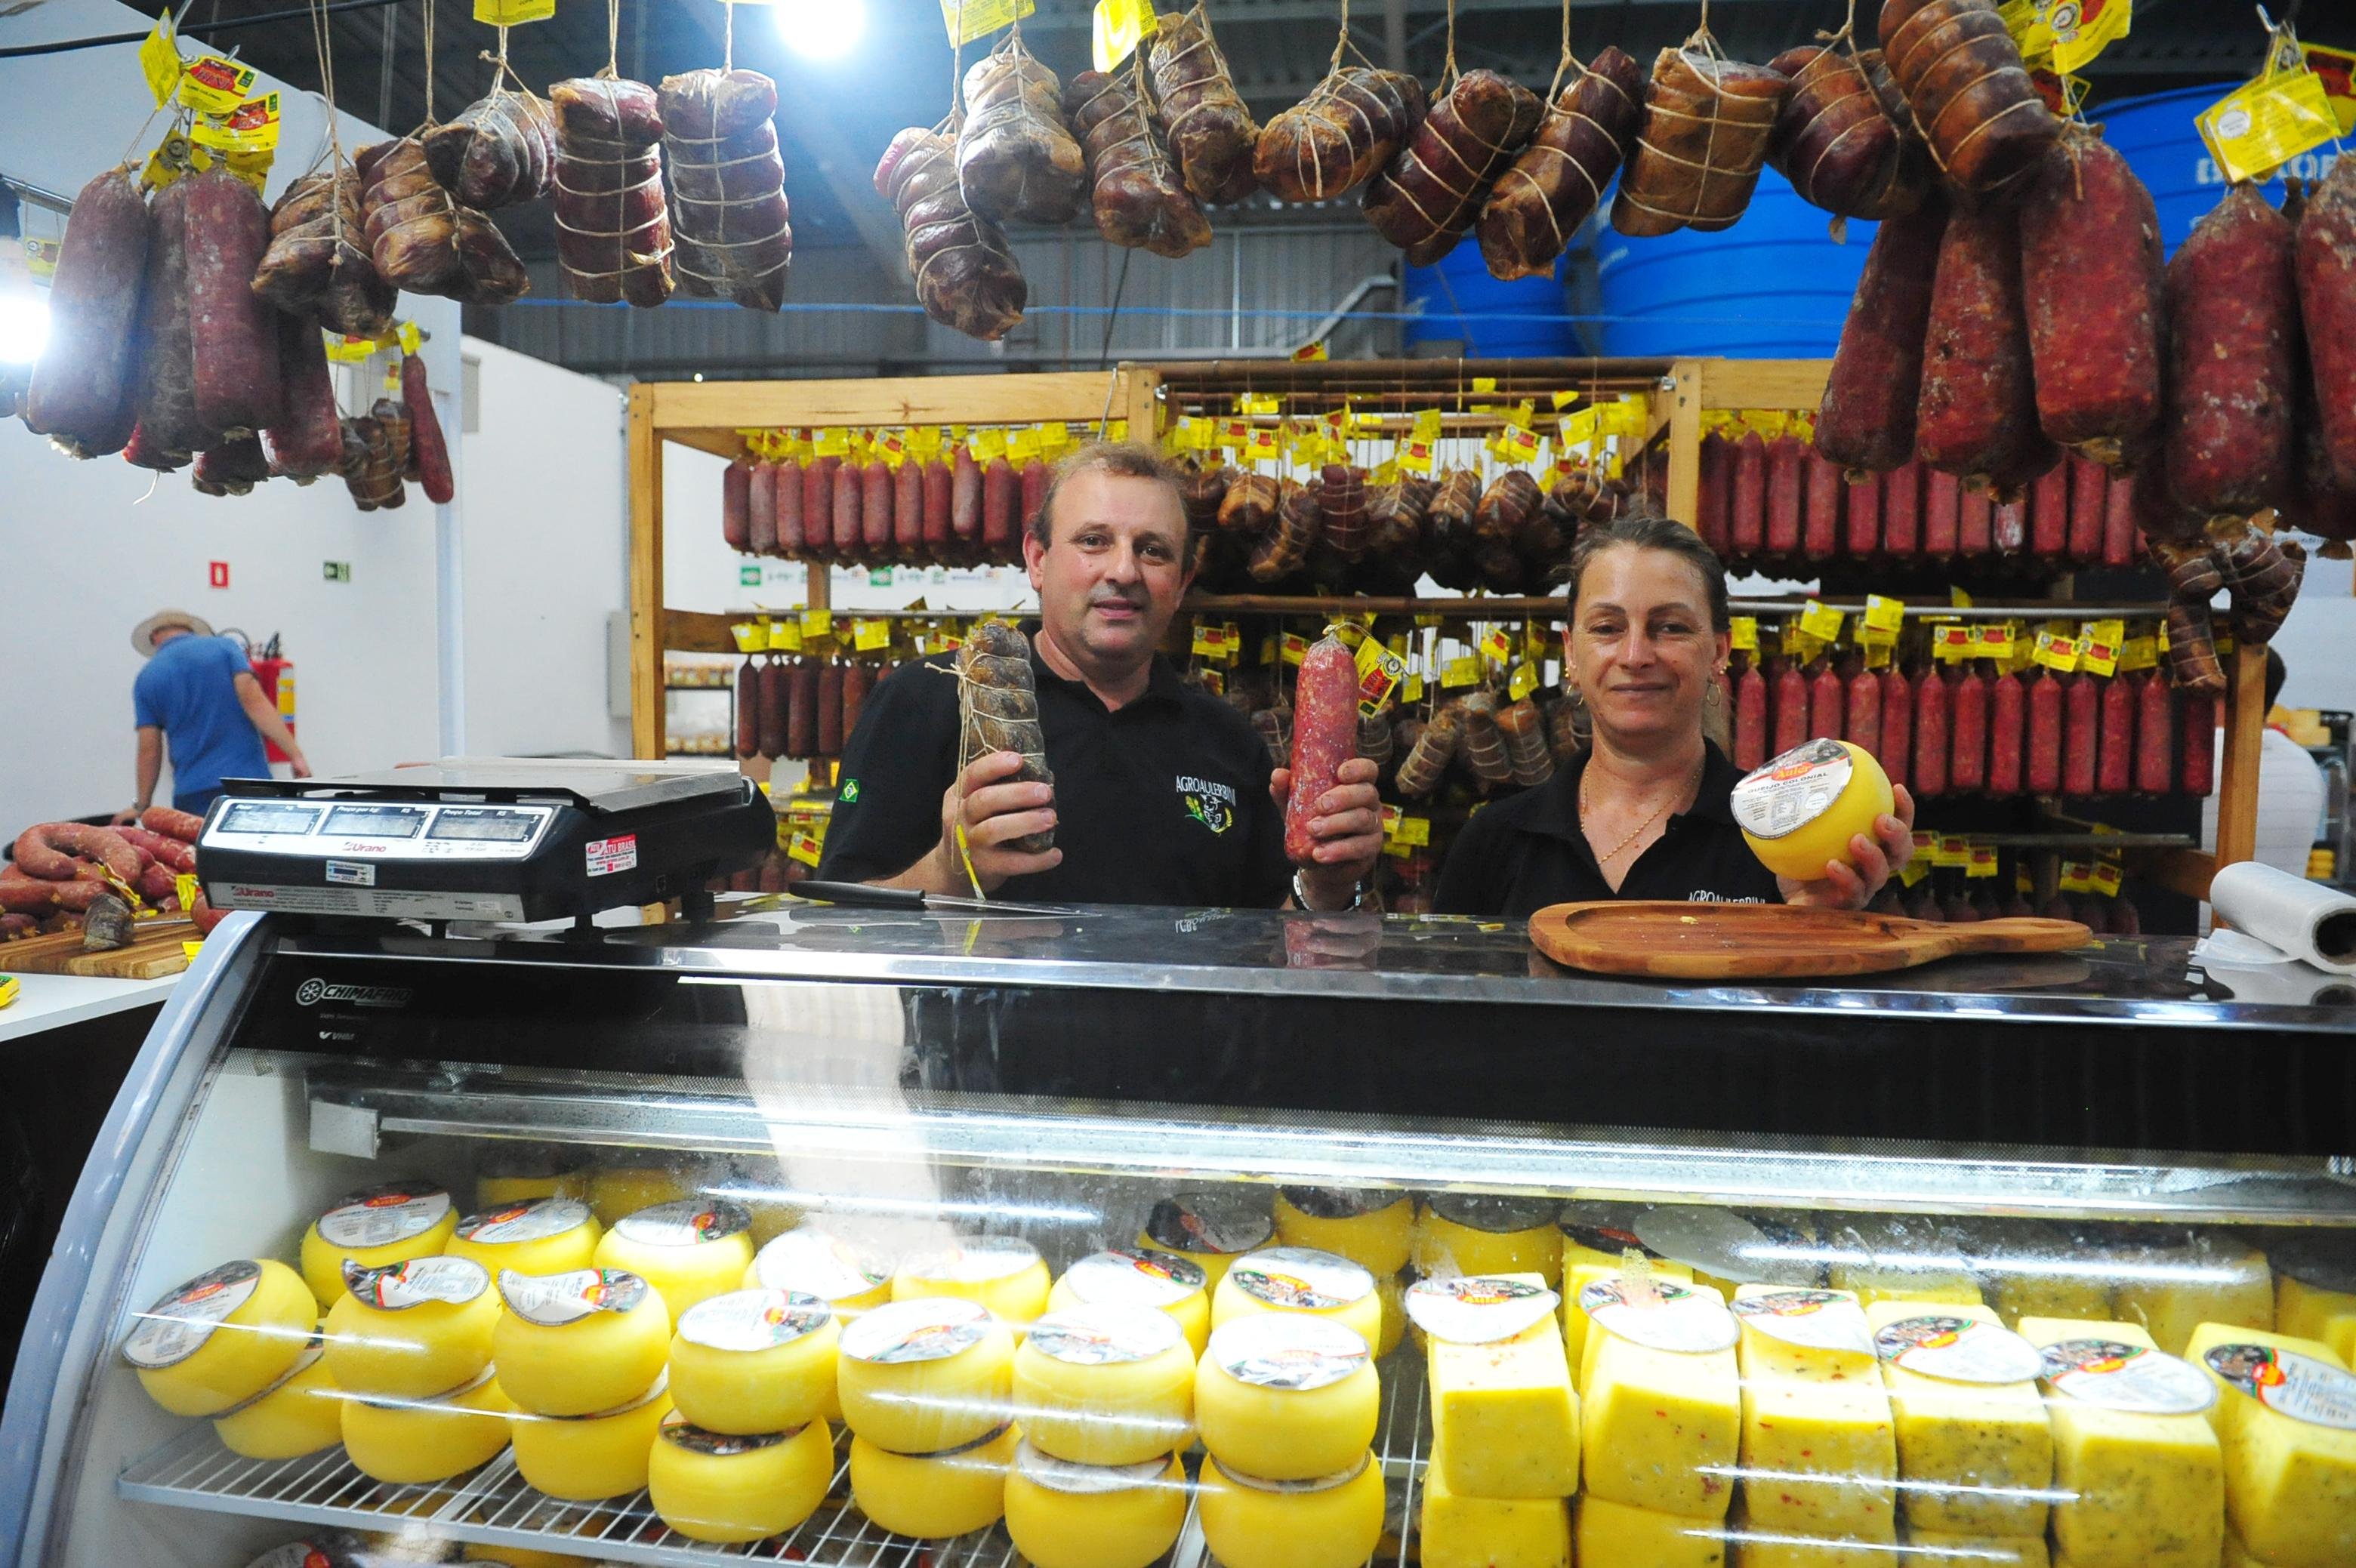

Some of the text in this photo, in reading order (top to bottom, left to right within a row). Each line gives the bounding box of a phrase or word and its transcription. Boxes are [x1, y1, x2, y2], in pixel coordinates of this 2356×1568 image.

[1747, 772, 1829, 793] QUEIJO COLONIAL
[1176, 775, 1237, 807] AGROAULERBINI
[353, 843, 387, 853] Urano
[241, 887, 275, 898] Urano
[323, 986, 412, 1000] CHIMAFRIO
